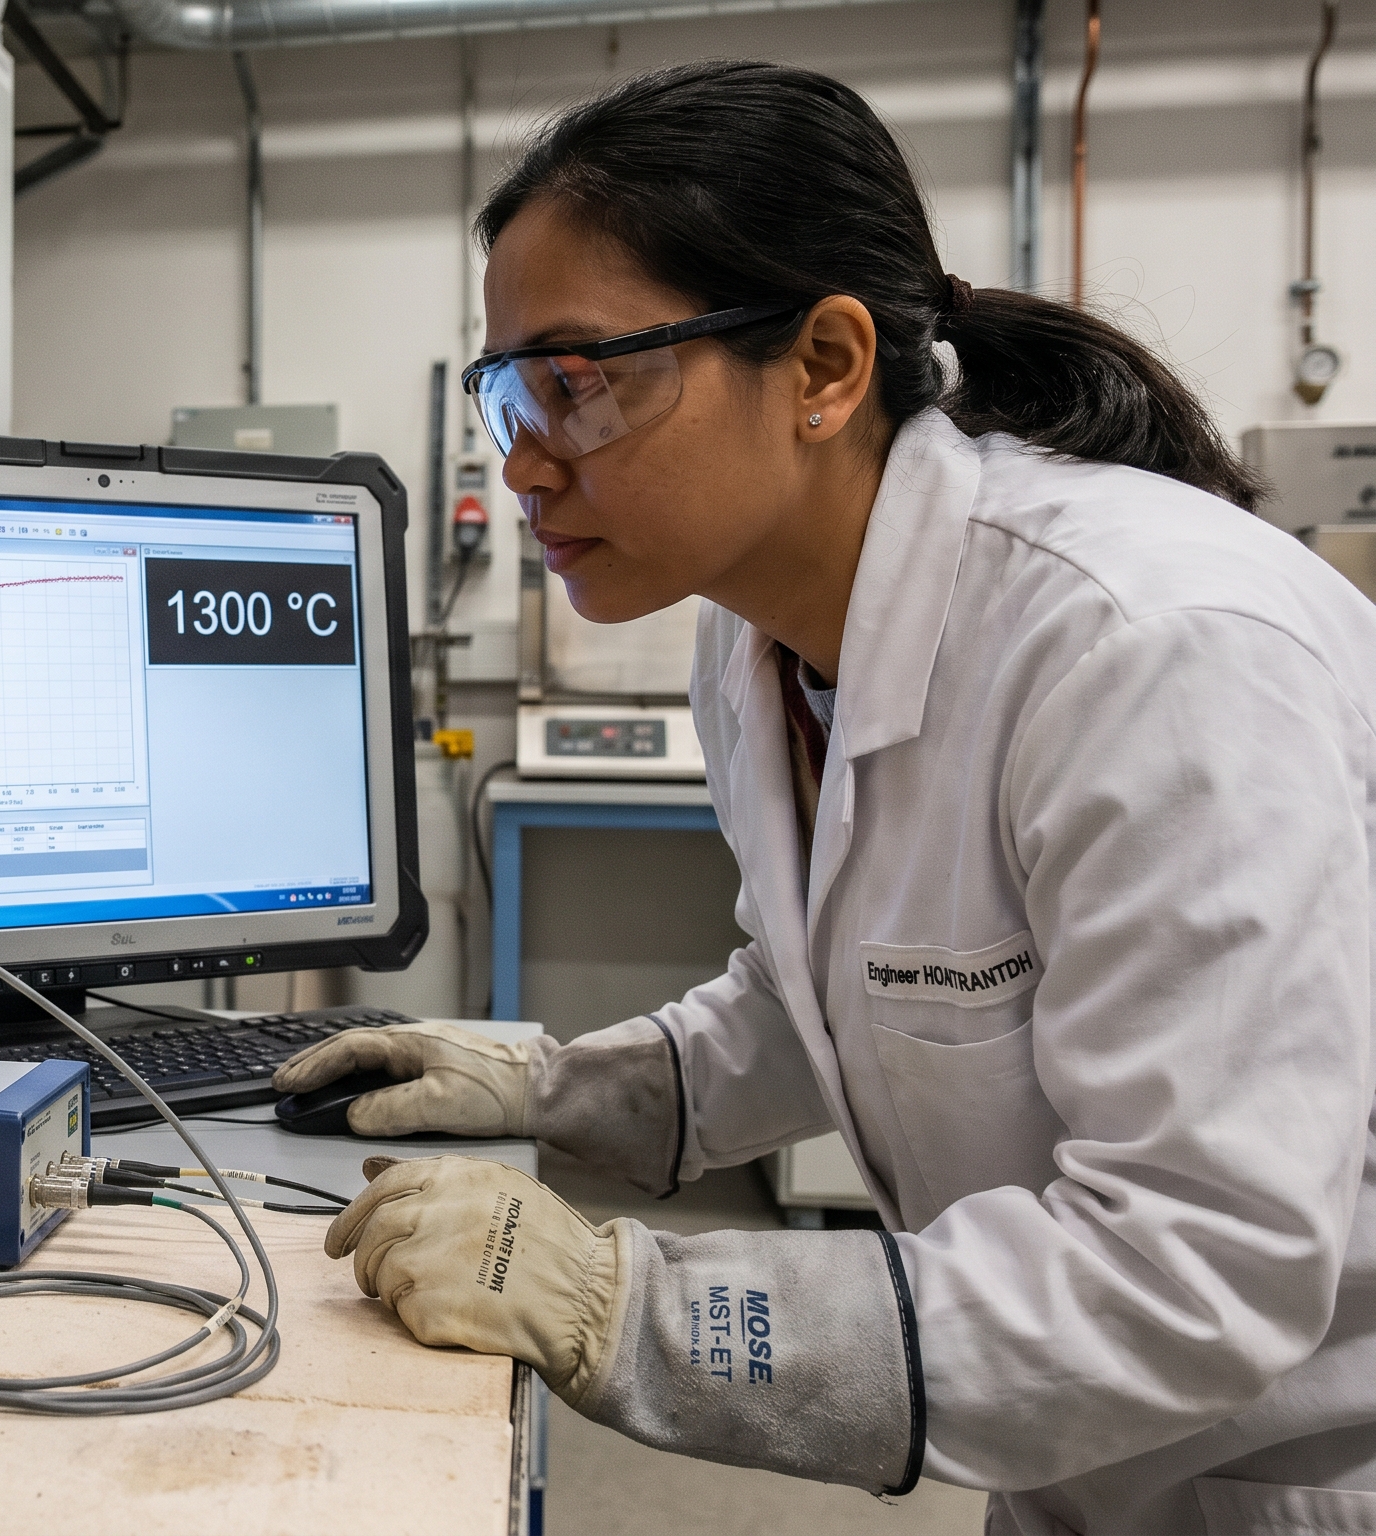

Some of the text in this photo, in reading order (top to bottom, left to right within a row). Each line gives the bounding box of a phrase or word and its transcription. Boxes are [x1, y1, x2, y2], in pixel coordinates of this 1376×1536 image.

[167, 589, 338, 637] 1300 °C
[867, 961, 920, 987] Engineer
[709, 1286, 733, 1383] MST-ET
